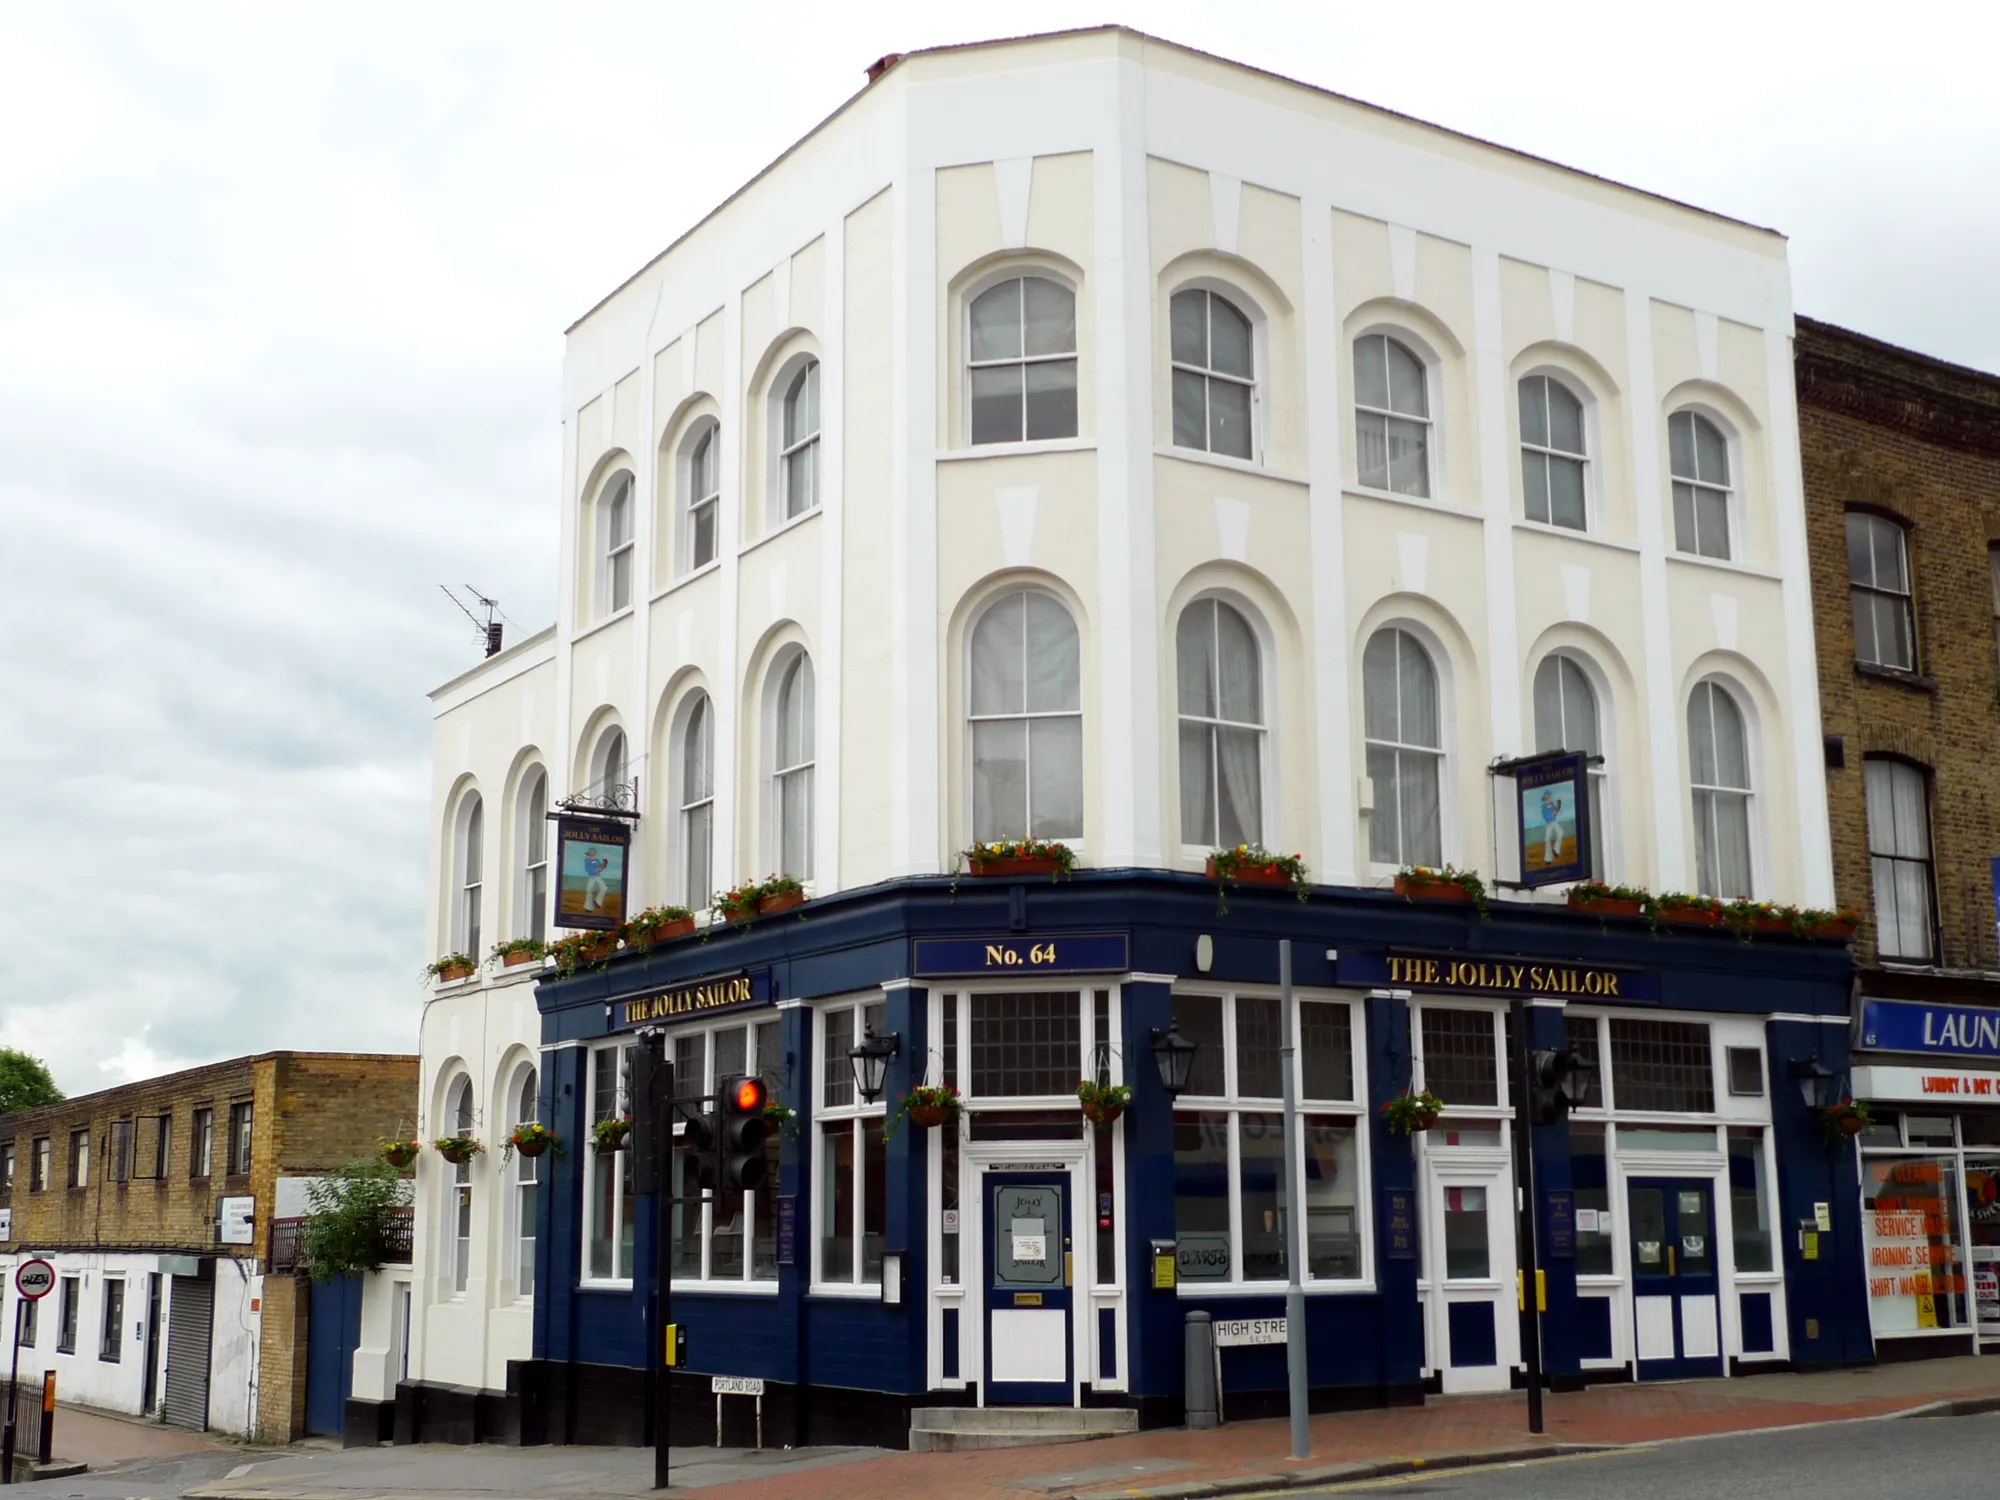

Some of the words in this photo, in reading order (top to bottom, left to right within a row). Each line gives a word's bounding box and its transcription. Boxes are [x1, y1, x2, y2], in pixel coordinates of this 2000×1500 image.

[563, 829, 592, 839] JOLLY
[593, 833, 625, 844] SAILOR
[985, 944, 1024, 966] No.
[1030, 943, 1056, 964] 64
[1386, 956, 1440, 985] THE
[1446, 961, 1525, 989] JOLLY
[1530, 966, 1619, 996] SAILOR
[624, 999, 649, 1023] THE
[652, 988, 694, 1018] JOLLY
[696, 977, 752, 1009] SAILOR
[1866, 1033, 1876, 1046] 65
[1963, 1077, 1971, 1095] &
[1972, 1078, 1992, 1095] DRY
[1015, 1195, 1043, 1210] JOLLY
[1875, 1217, 1917, 1236] SERVICE
[1920, 1216, 1949, 1236] WASH
[1871, 1246, 1913, 1266] IRONING
[1915, 1244, 1958, 1265] SERVICE
[1217, 1322, 1249, 1337] HIGH
[1253, 1320, 1286, 1335] STRE
[715, 1379, 744, 1392] PORTLAND
[745, 1380, 761, 1393] ROAD
